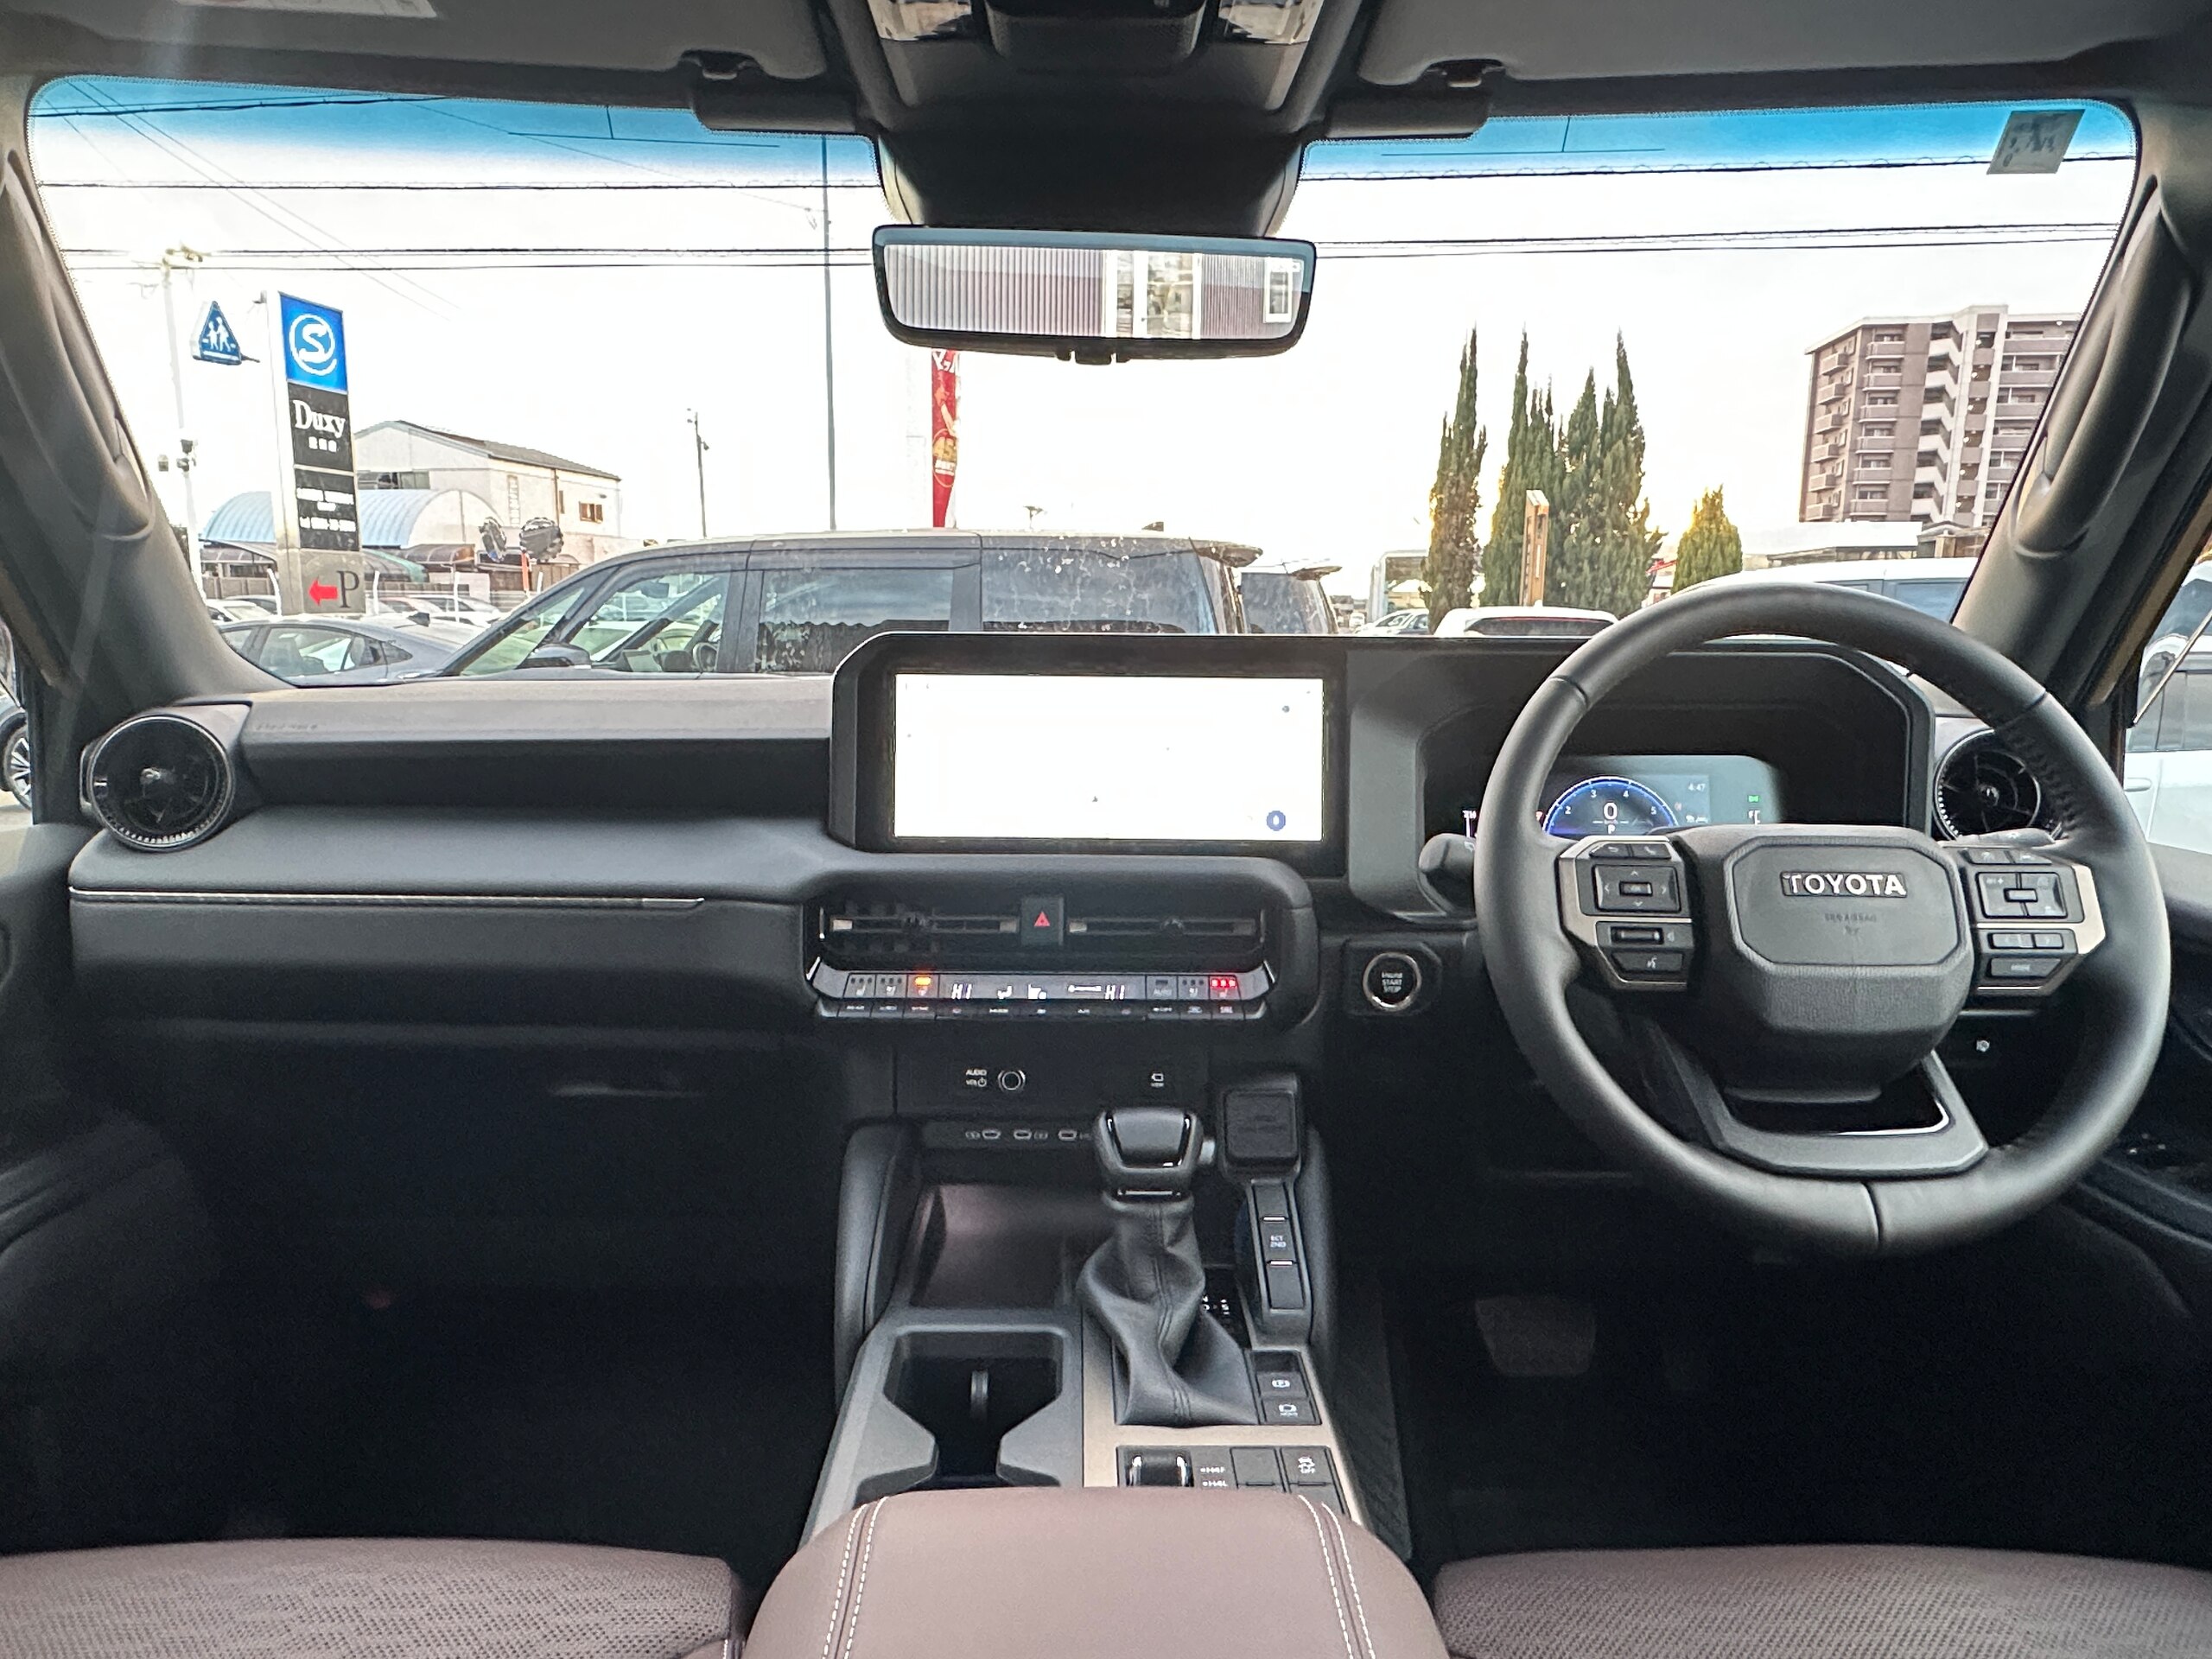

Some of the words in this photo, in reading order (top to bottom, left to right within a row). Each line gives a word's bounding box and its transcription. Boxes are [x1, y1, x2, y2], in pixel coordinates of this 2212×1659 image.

[293, 400, 346, 438] Duxy
[337, 571, 359, 608] P
[1591, 790, 1597, 798] 3
[1564, 806, 1571, 815] 2
[1603, 802, 1618, 820] 0
[1789, 874, 1907, 895] TOYOTA
